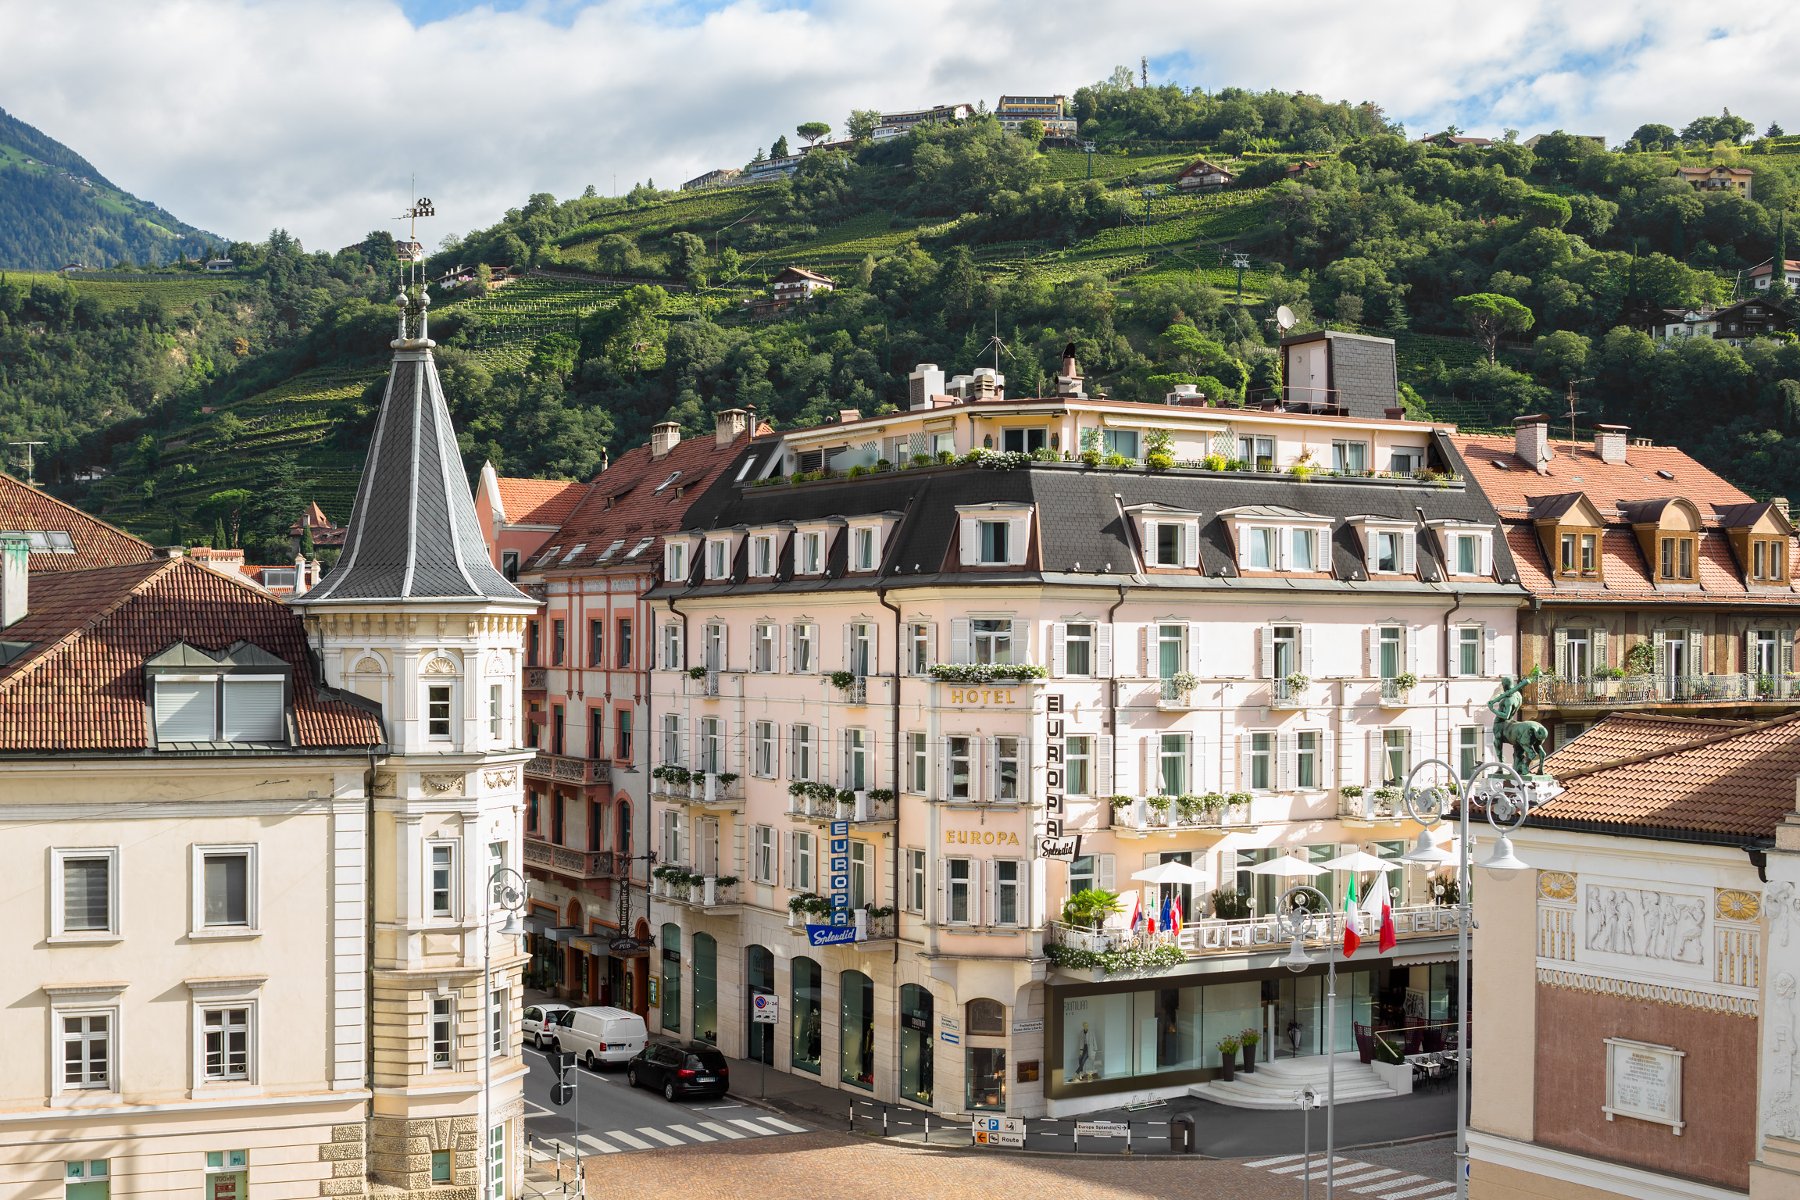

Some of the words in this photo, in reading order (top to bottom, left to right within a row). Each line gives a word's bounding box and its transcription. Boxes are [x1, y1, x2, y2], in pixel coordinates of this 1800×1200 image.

[951, 689, 1015, 704] HOTEL
[1047, 696, 1059, 836] EUROPA
[946, 830, 1020, 846] EUROPA
[1041, 839, 1074, 857] Splendid
[834, 822, 847, 924] EUROPA
[813, 928, 856, 945] Splendid
[990, 1120, 997, 1129] P
